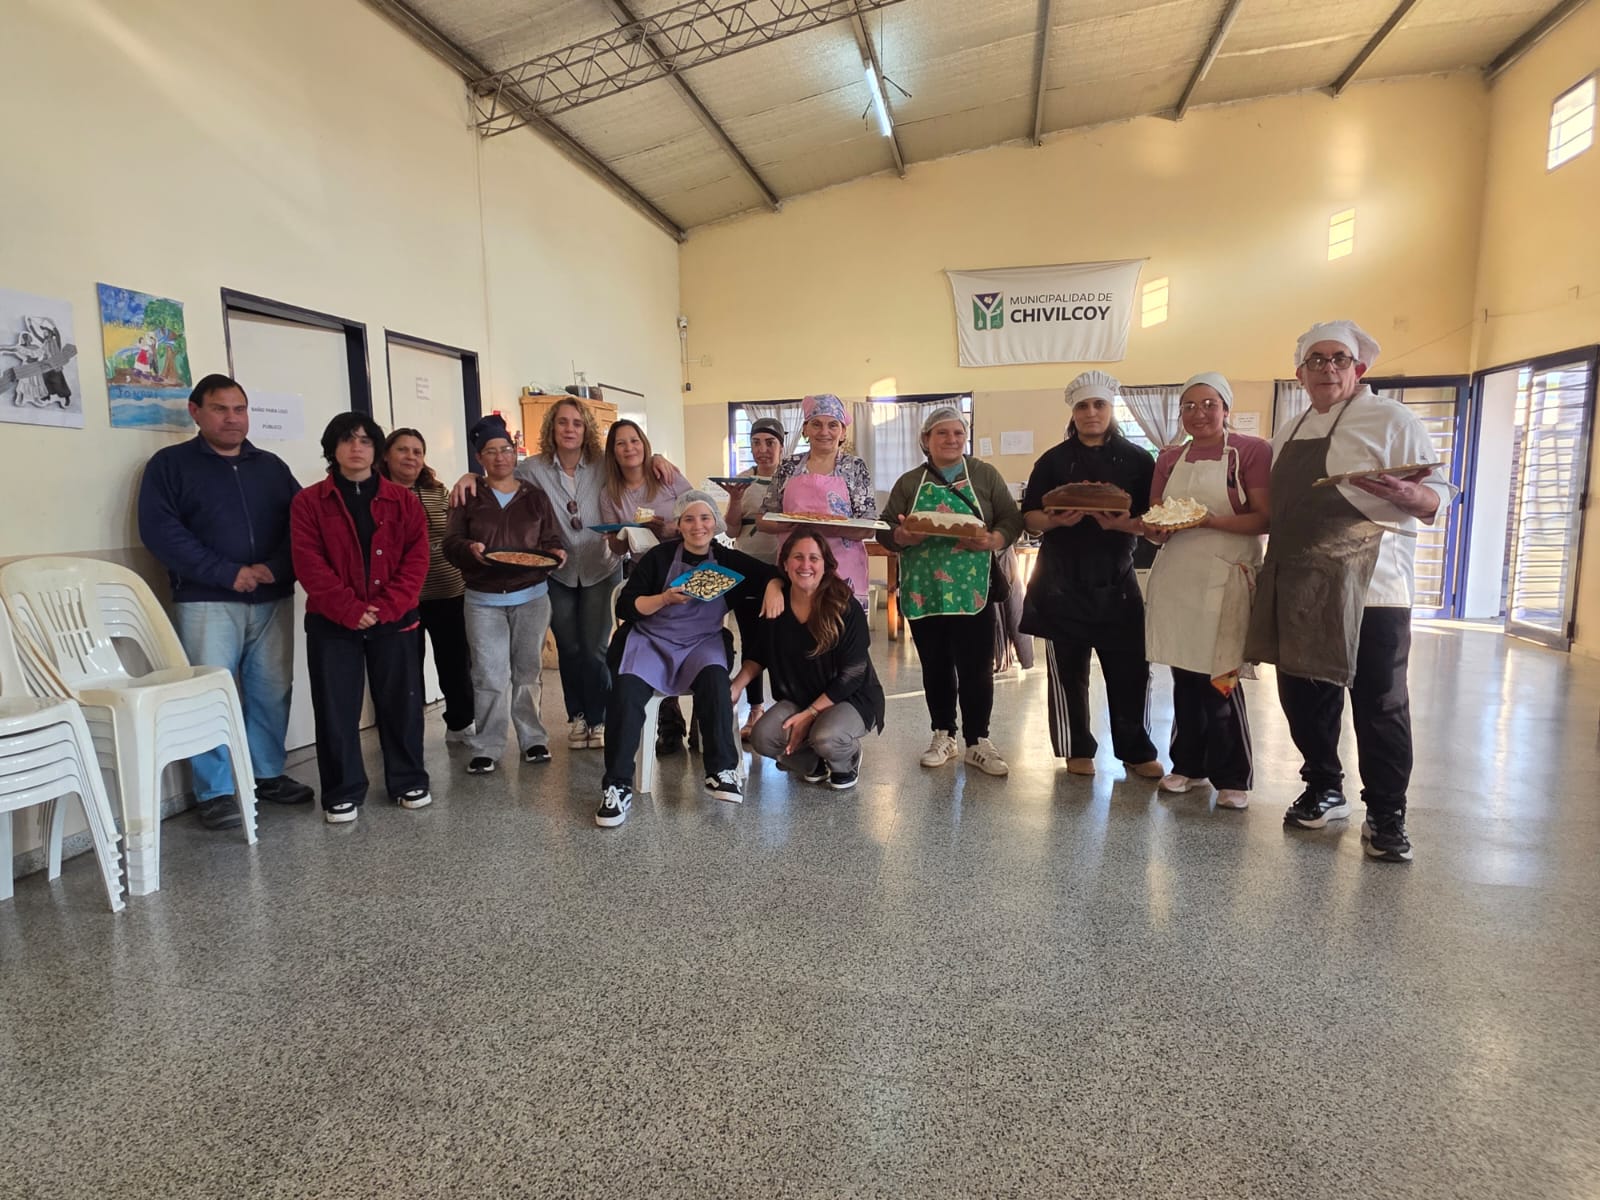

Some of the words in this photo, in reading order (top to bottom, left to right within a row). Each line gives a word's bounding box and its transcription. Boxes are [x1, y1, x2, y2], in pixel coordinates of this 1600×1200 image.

[1010, 293, 1096, 305] MUNICIPALIDAD
[1097, 292, 1113, 302] DE
[1010, 305, 1111, 323] CHIVILCOY
